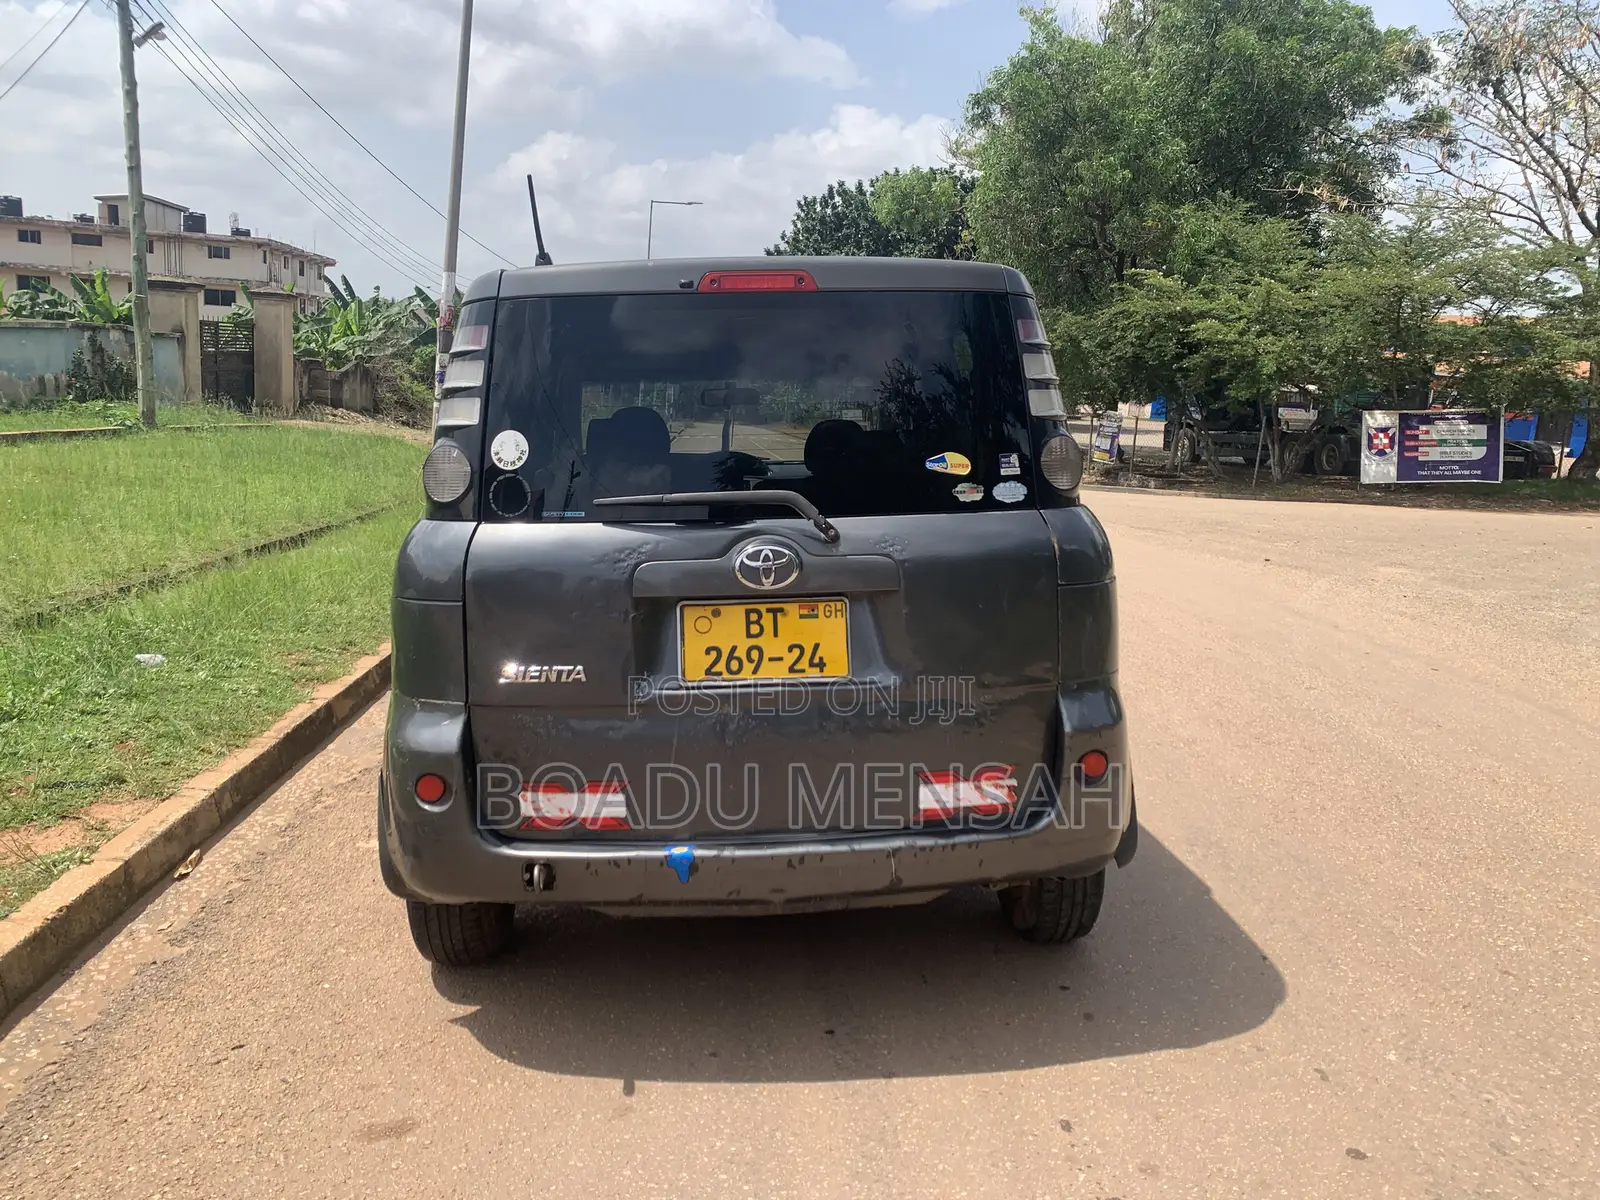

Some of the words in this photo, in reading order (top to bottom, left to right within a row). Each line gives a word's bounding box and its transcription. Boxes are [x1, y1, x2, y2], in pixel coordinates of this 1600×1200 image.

[744, 607, 785, 639] BT
[823, 603, 844, 619] GH
[499, 662, 588, 683] SIENTA
[704, 642, 827, 677] 269-24
